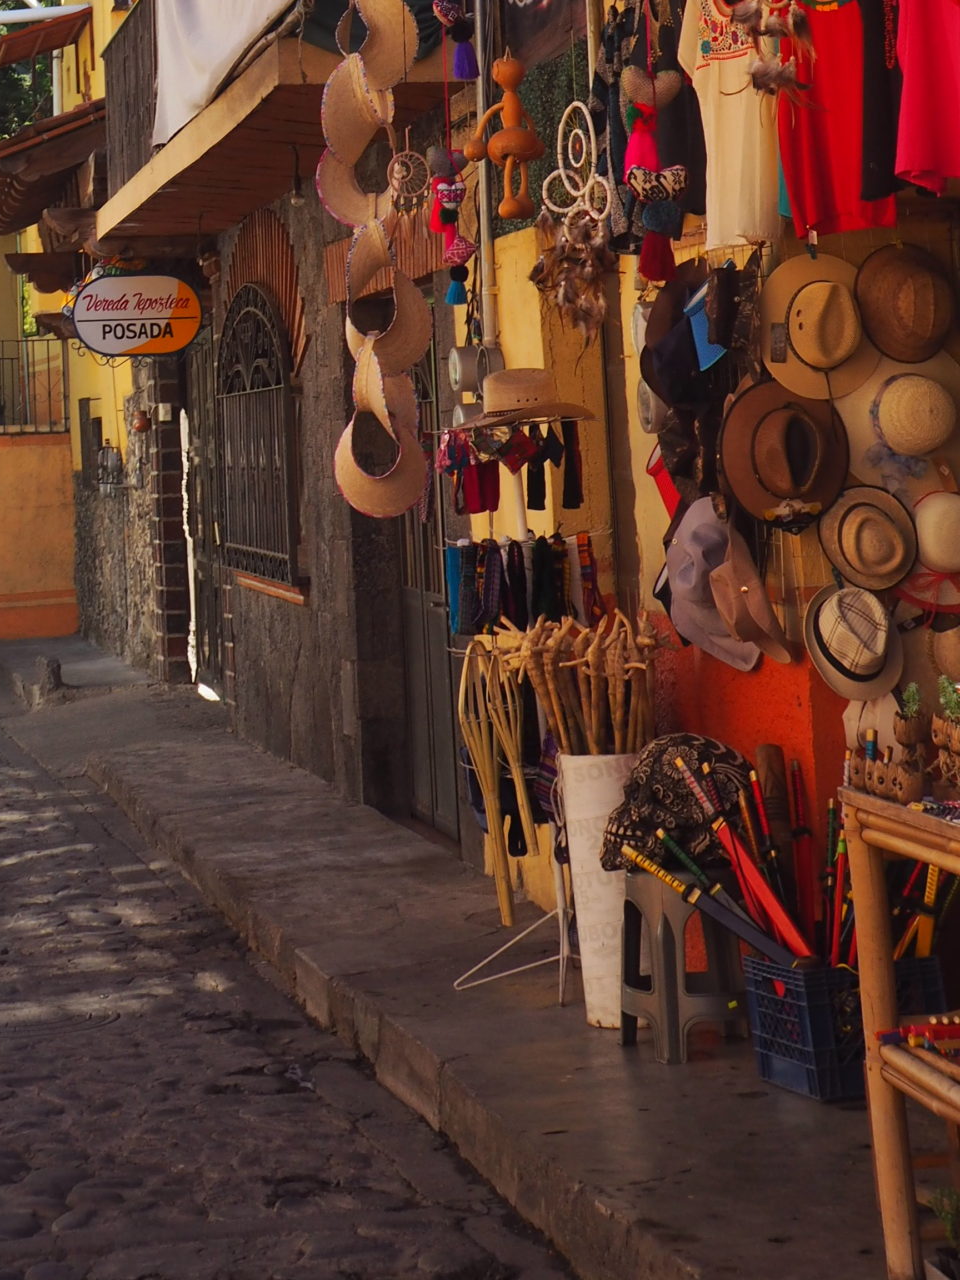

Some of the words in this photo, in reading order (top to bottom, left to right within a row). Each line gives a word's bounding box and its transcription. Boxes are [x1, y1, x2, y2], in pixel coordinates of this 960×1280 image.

[82, 294, 129, 312] Vereda
[132, 293, 190, 315] Tepozteca
[102, 322, 174, 340] POSADA
